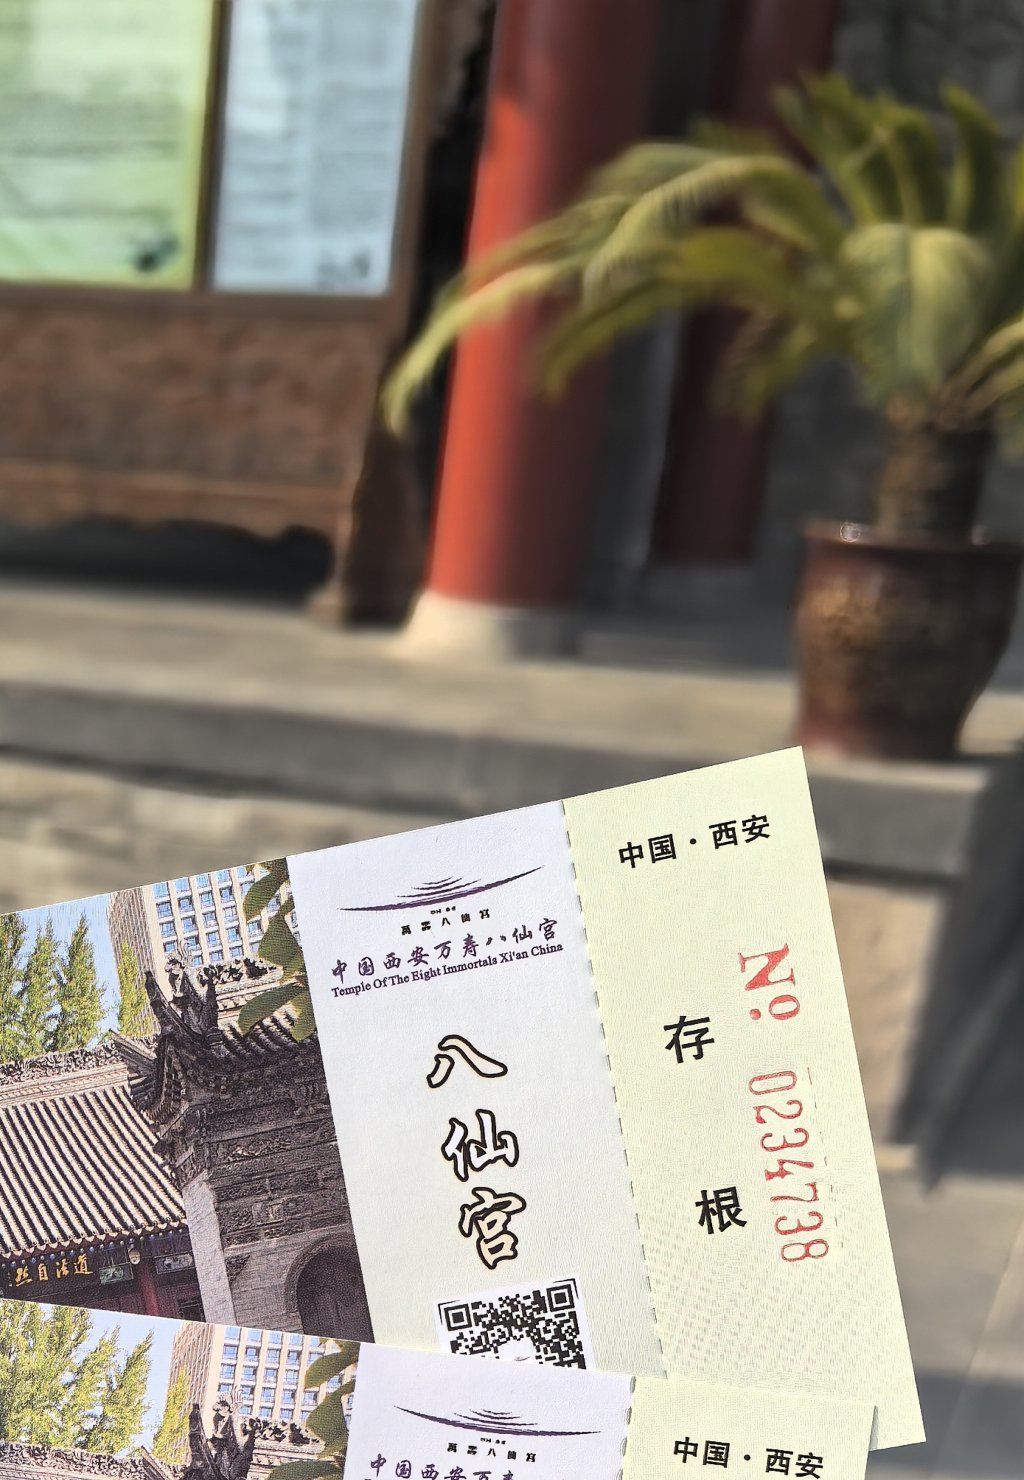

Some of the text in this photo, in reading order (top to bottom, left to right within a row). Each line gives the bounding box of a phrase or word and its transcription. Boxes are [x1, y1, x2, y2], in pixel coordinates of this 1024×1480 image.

[332, 918, 558, 983] 中国西安万寿八仙宫
[332, 942, 564, 998] Temple Of The Eight Immortals Xi'an China
[426, 1034, 527, 1270] 八仙宫
[747, 1068, 830, 1263] 0234738
